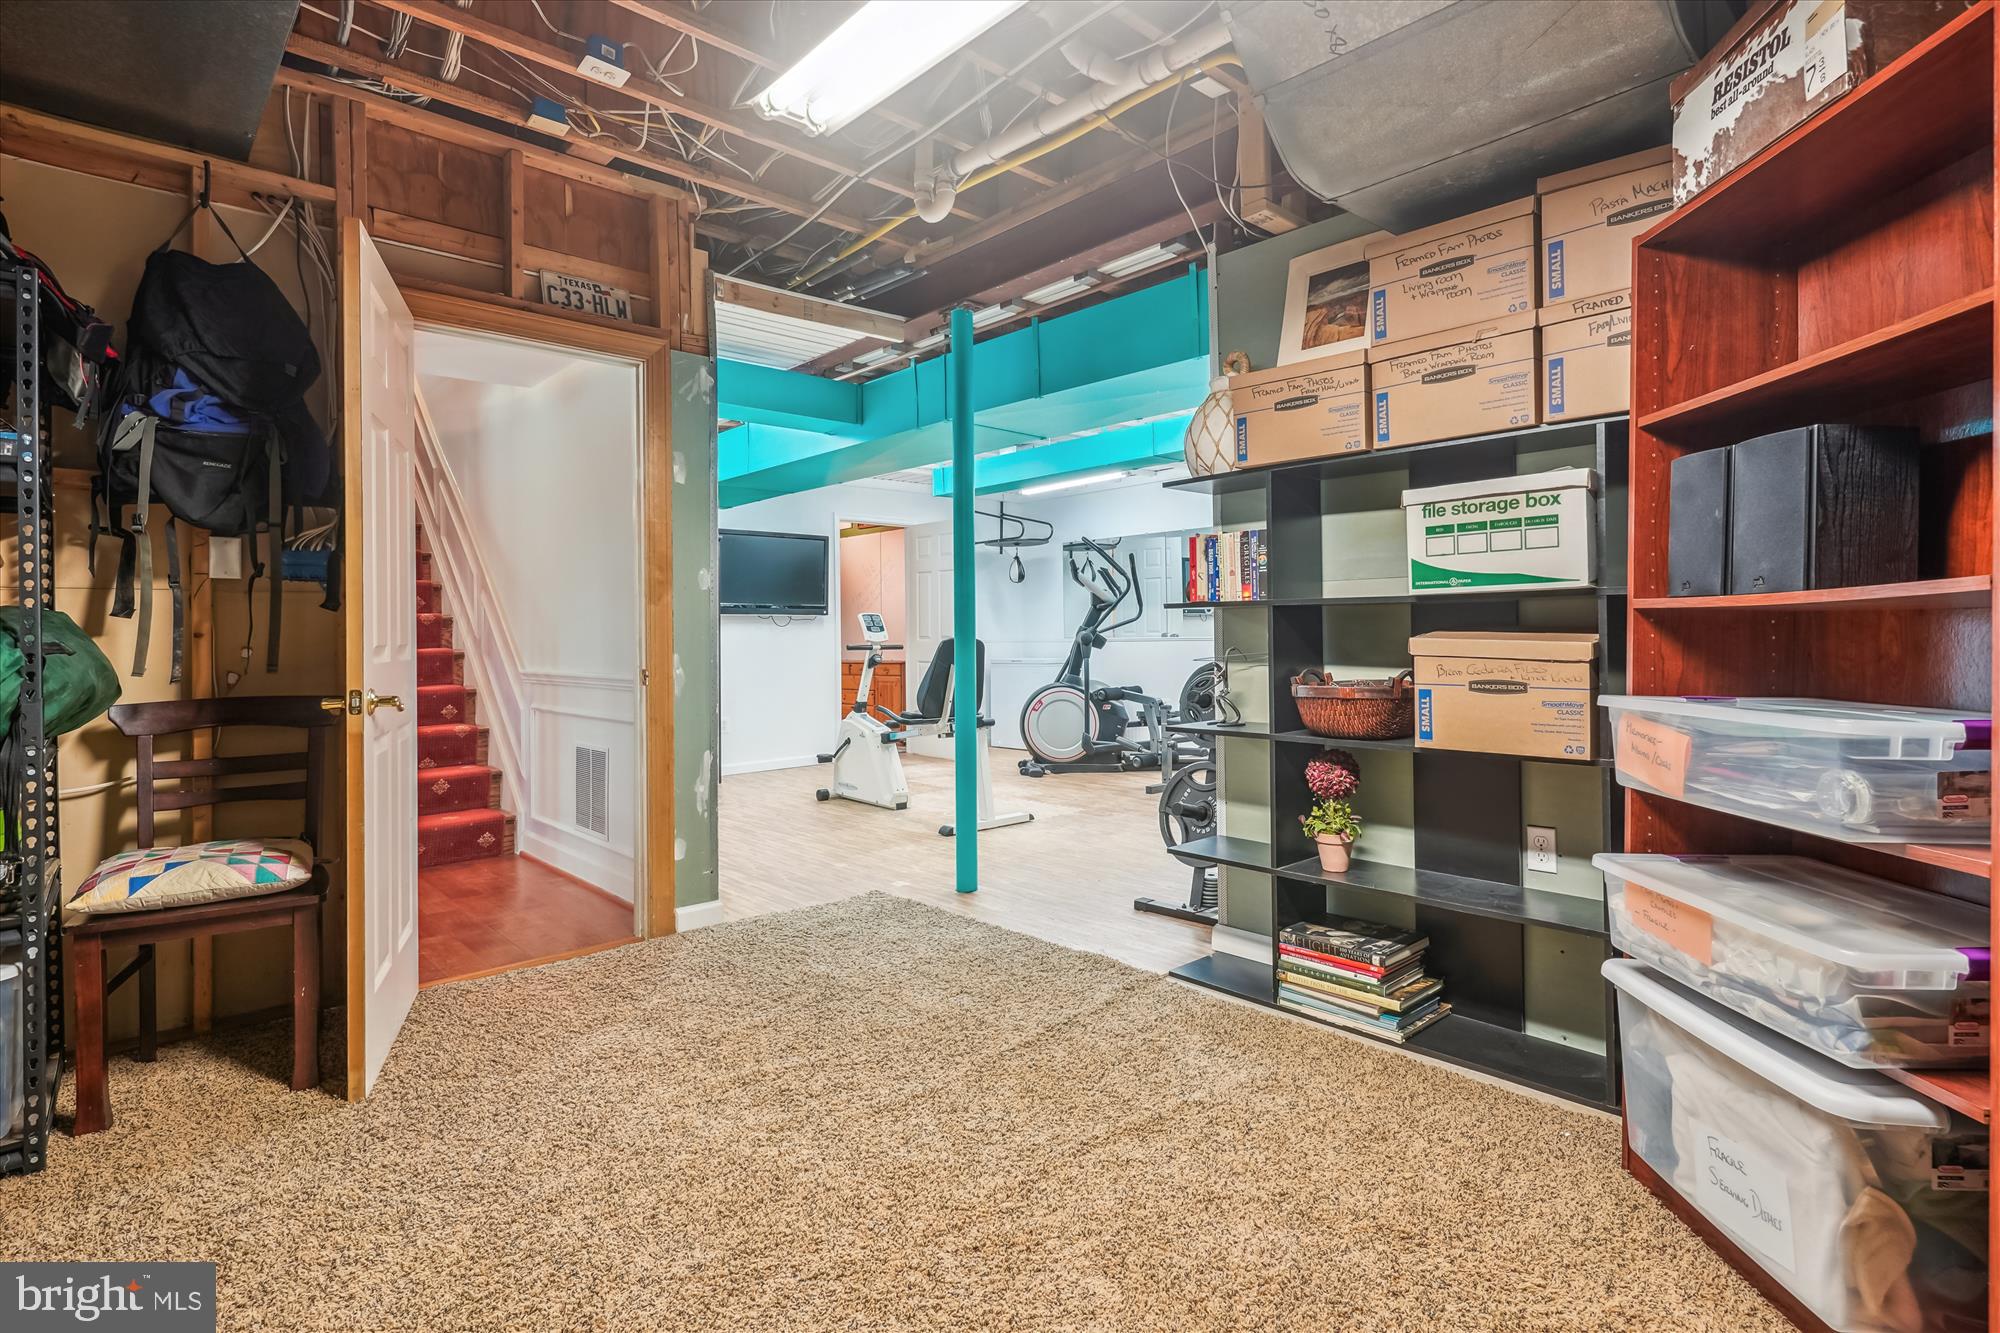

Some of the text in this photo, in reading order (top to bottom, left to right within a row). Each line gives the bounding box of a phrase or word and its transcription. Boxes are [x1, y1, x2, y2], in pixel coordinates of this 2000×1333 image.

[1712, 26, 1791, 106] RESISTOL
[1806, 63, 1816, 92] 7
[1711, 60, 1774, 120] best all-around
[1610, 200, 1675, 223] BANKERS BOX
[1422, 257, 1473, 276] BANKERS BOX
[1501, 268, 1527, 278] CLASSIC
[1551, 249, 1561, 290] SMALL
[563, 278, 592, 291] TEXAS
[1375, 297, 1385, 332] SMALL
[1572, 295, 1624, 314] FRAMED
[1424, 367, 1473, 382] BANKERS BOX
[1503, 380, 1528, 389] CLASSIC
[1551, 366, 1561, 405] SMALL
[1276, 400, 1303, 409] BANKERS
[1379, 399, 1388, 434] SMALL
[1421, 492, 1562, 519] file storage box
[1421, 696, 1430, 732] SMALL
[1340, 953, 1371, 964] AVIATION
[1347, 949, 1363, 957] YEARS
